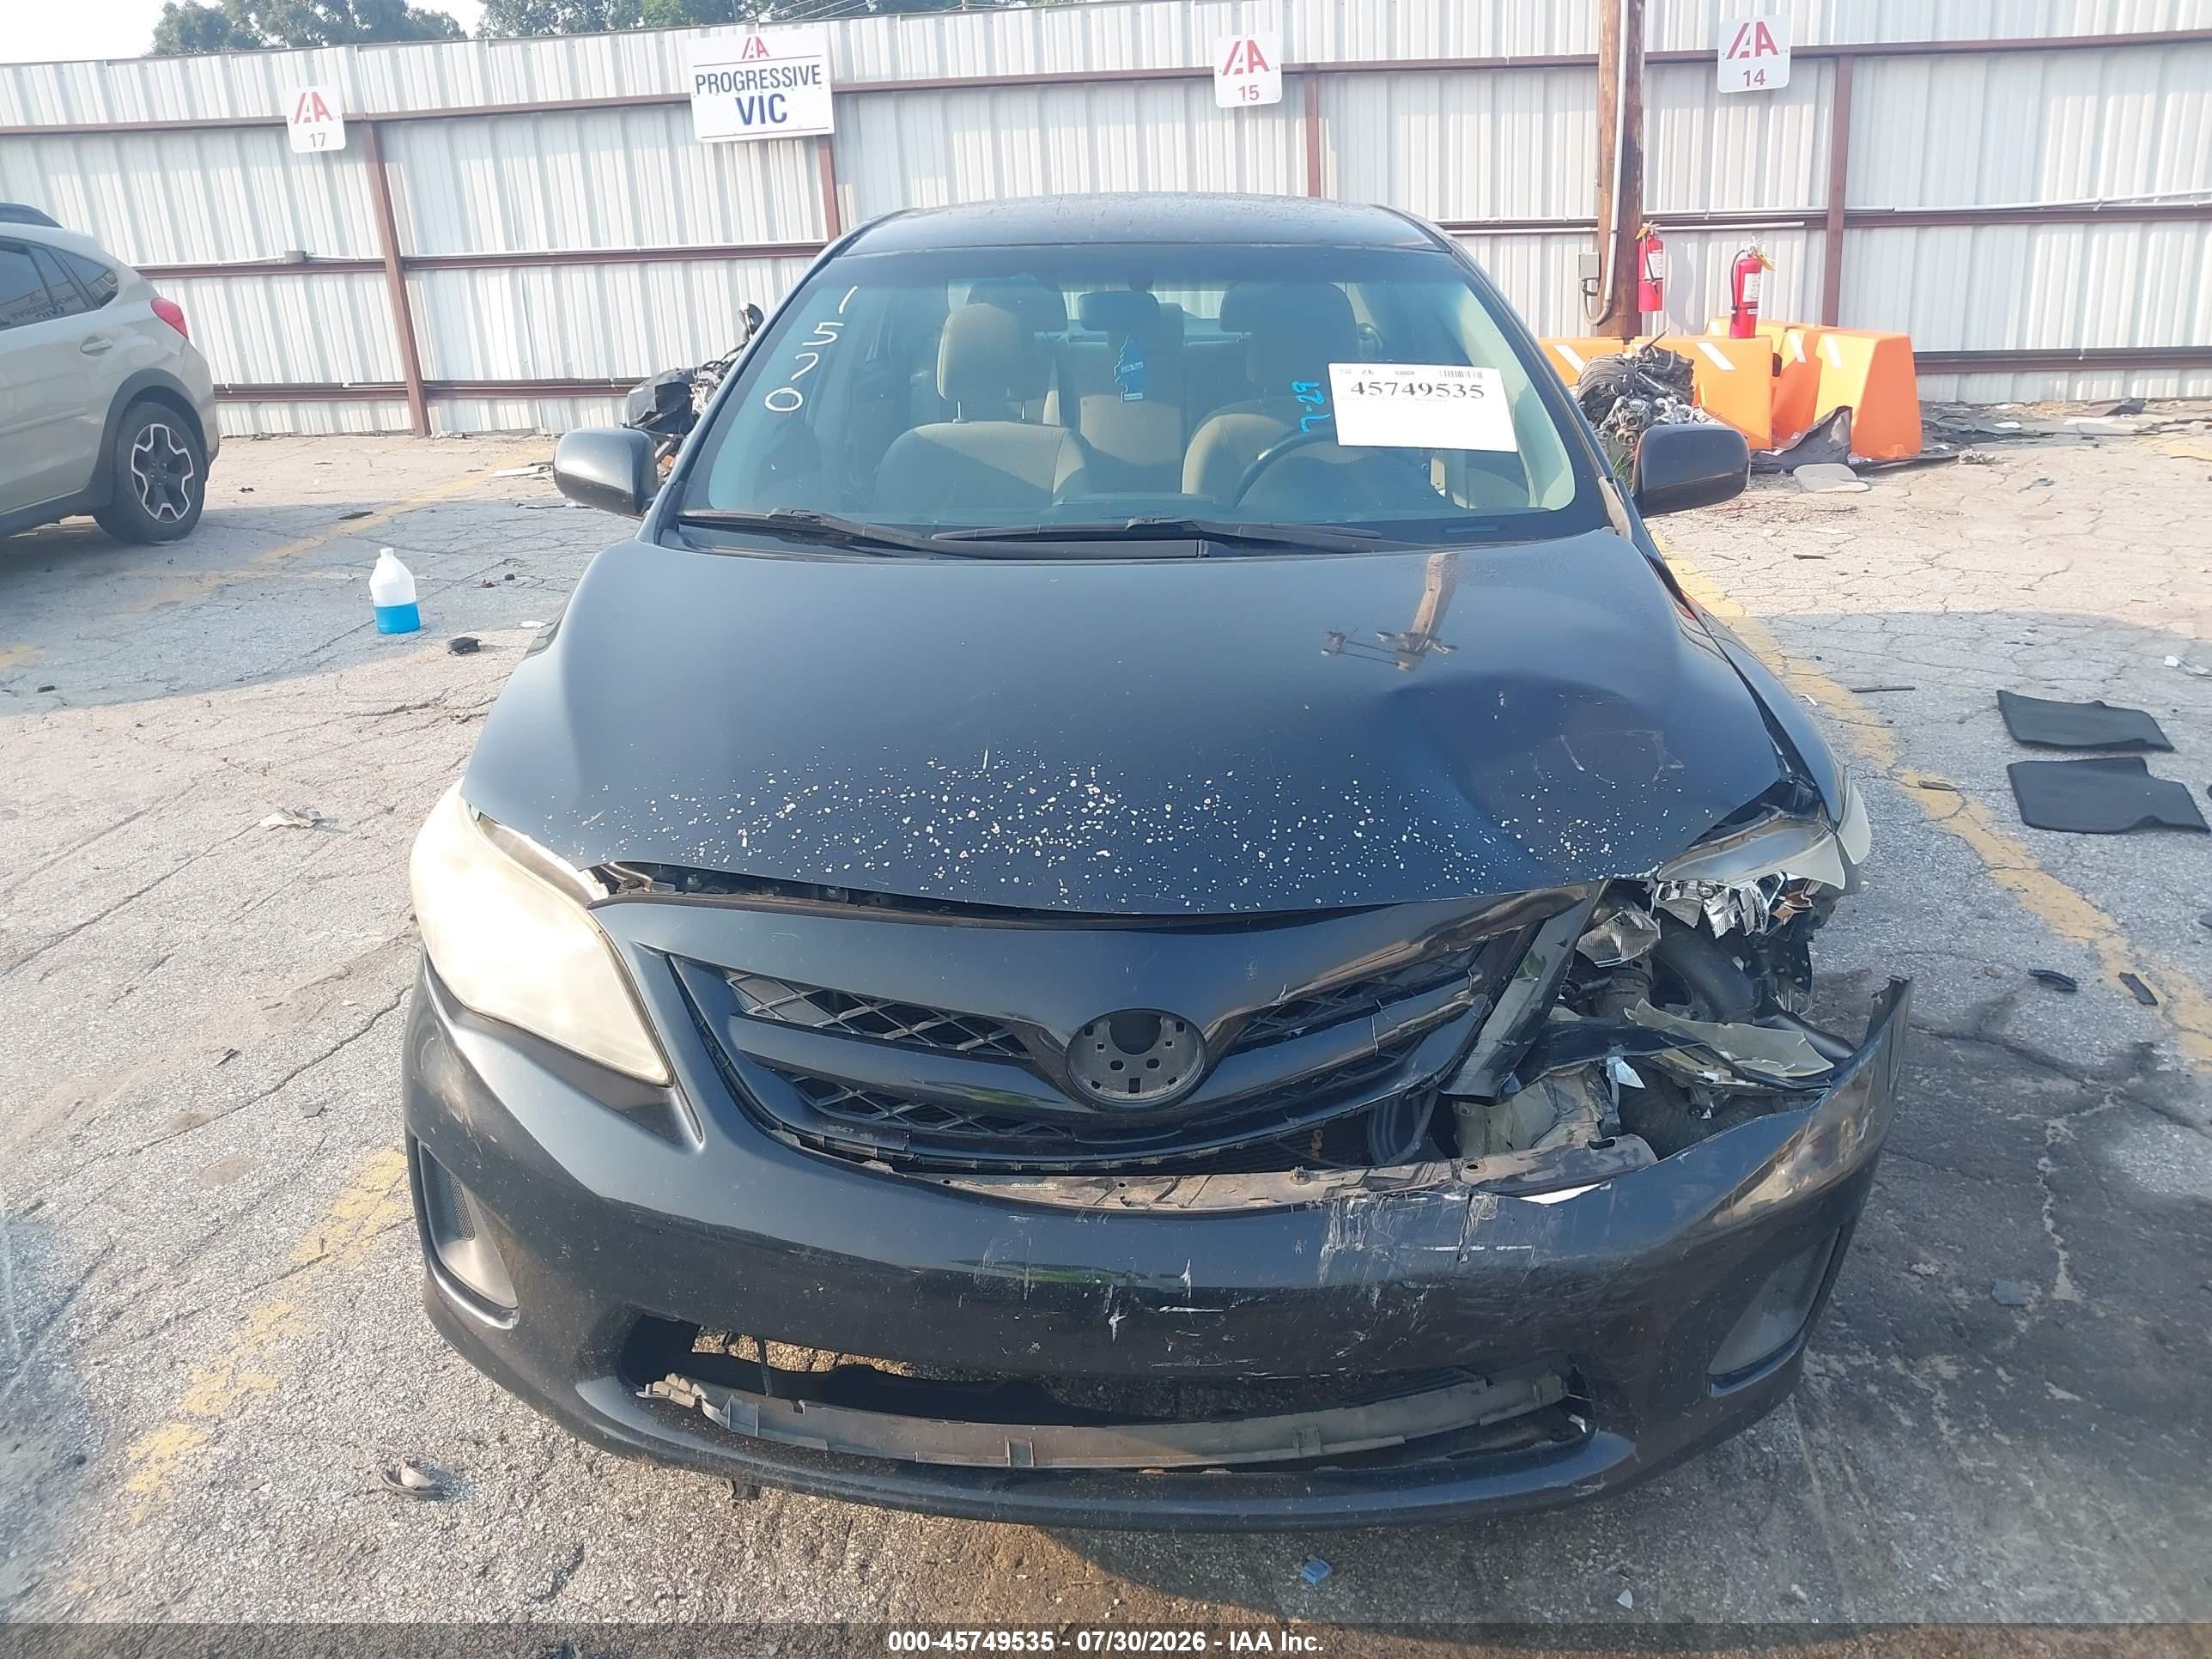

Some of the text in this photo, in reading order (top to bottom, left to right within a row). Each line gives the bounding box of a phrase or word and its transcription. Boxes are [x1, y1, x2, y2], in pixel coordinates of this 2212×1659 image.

[695, 64, 823, 95] PROGRESSIVE
[1742, 69, 1766, 87] 14
[1238, 84, 1260, 101] 15
[734, 93, 787, 125] VIC
[309, 131, 326, 148] 17
[1351, 380, 1485, 399] 45749535
